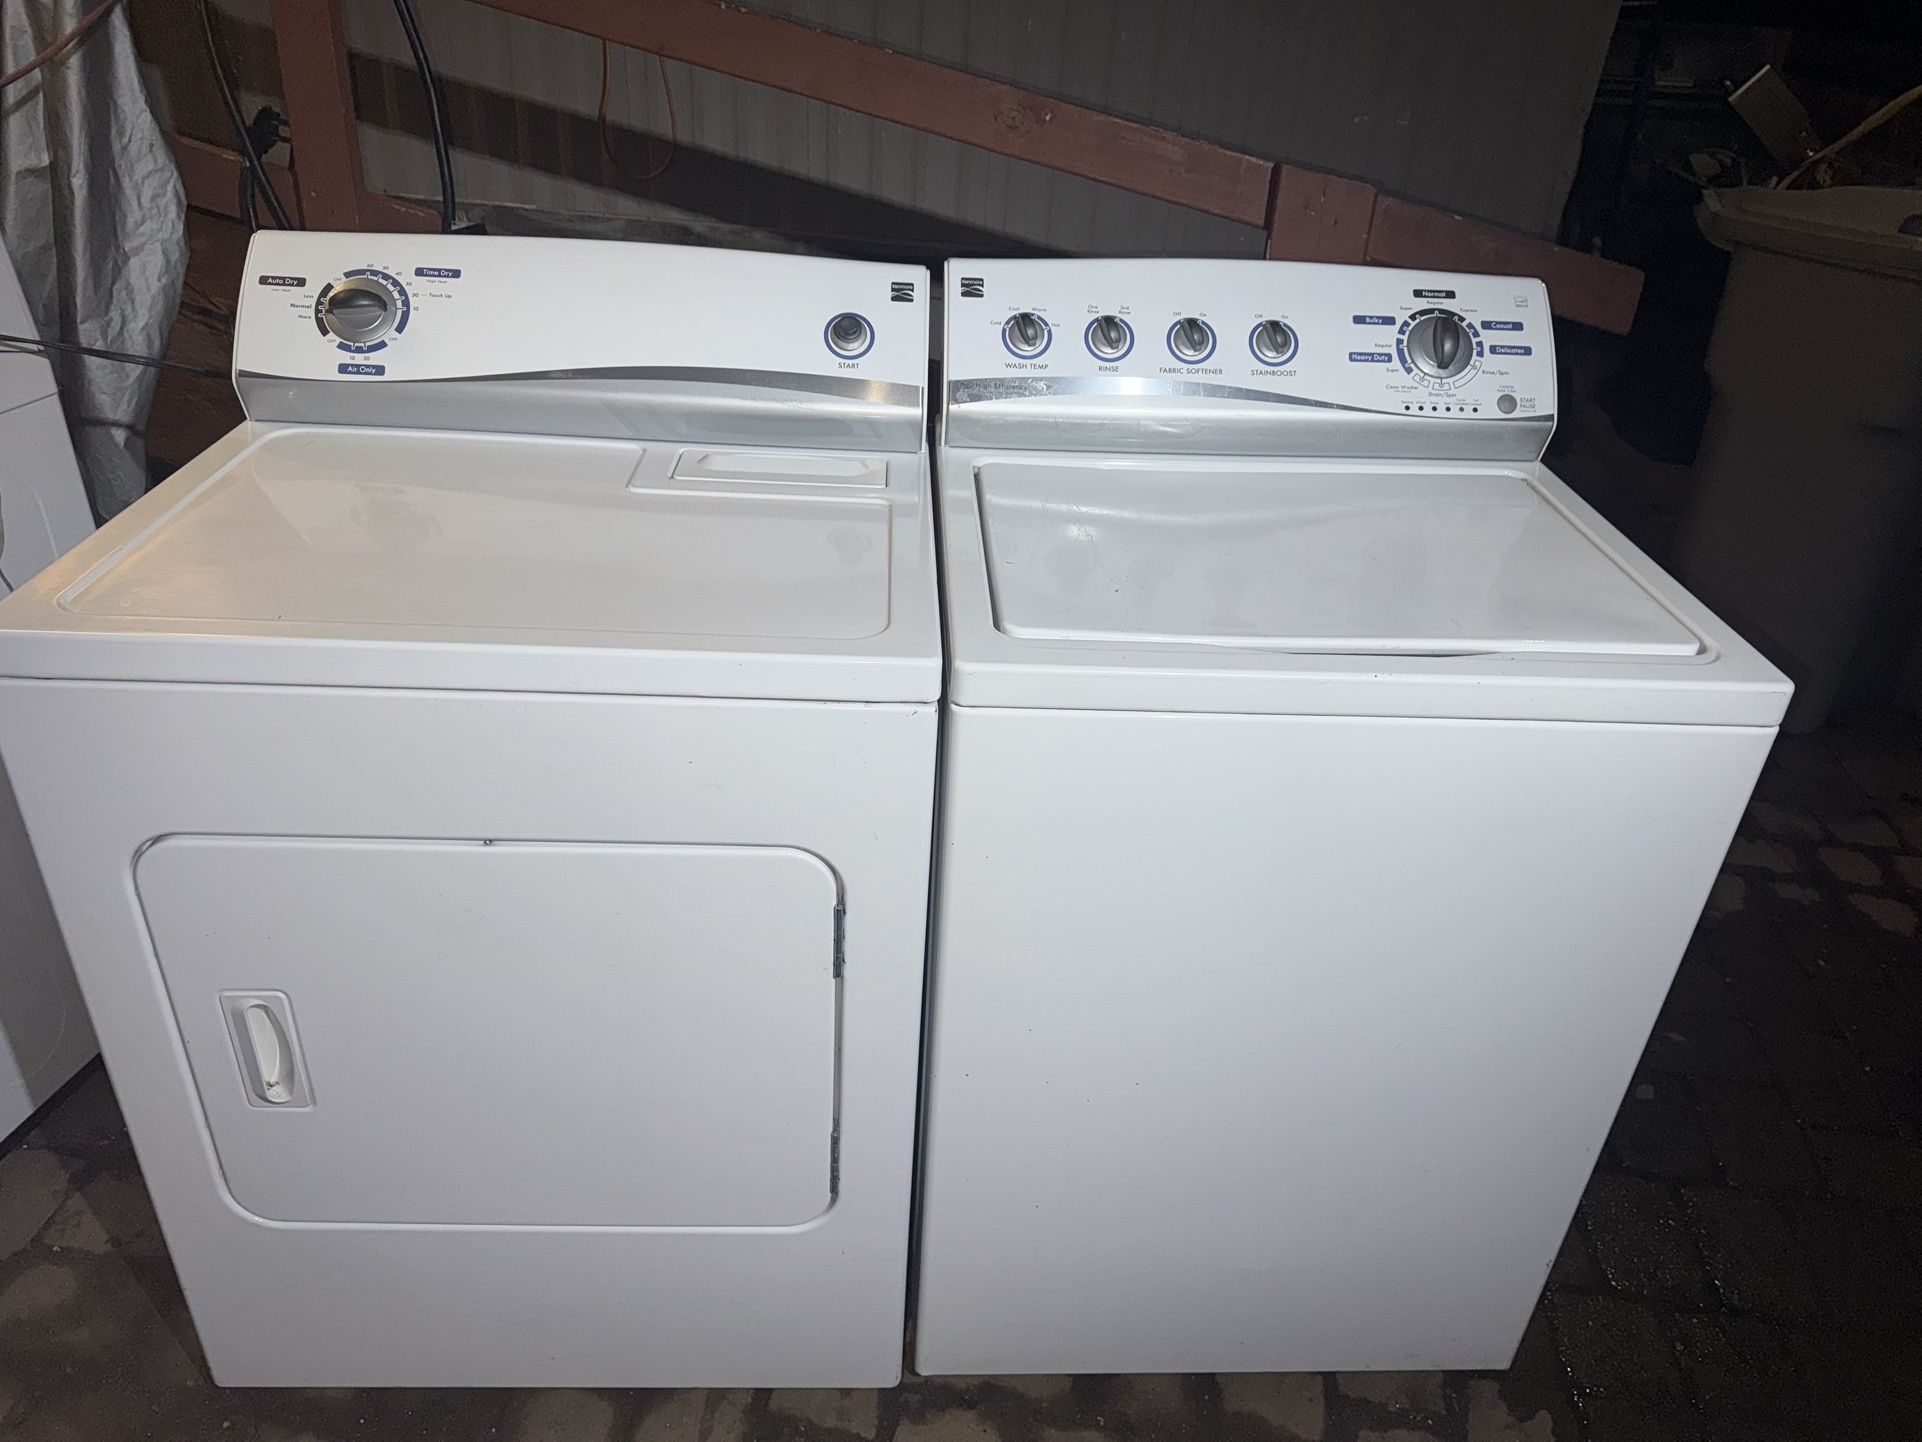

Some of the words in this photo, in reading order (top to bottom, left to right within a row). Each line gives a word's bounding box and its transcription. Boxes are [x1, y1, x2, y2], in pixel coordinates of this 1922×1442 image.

[360, 366, 376, 374] Only
[838, 362, 860, 370] START
[1186, 368, 1223, 376] SOFTENER
[1250, 369, 1297, 377] STAINBOOST
